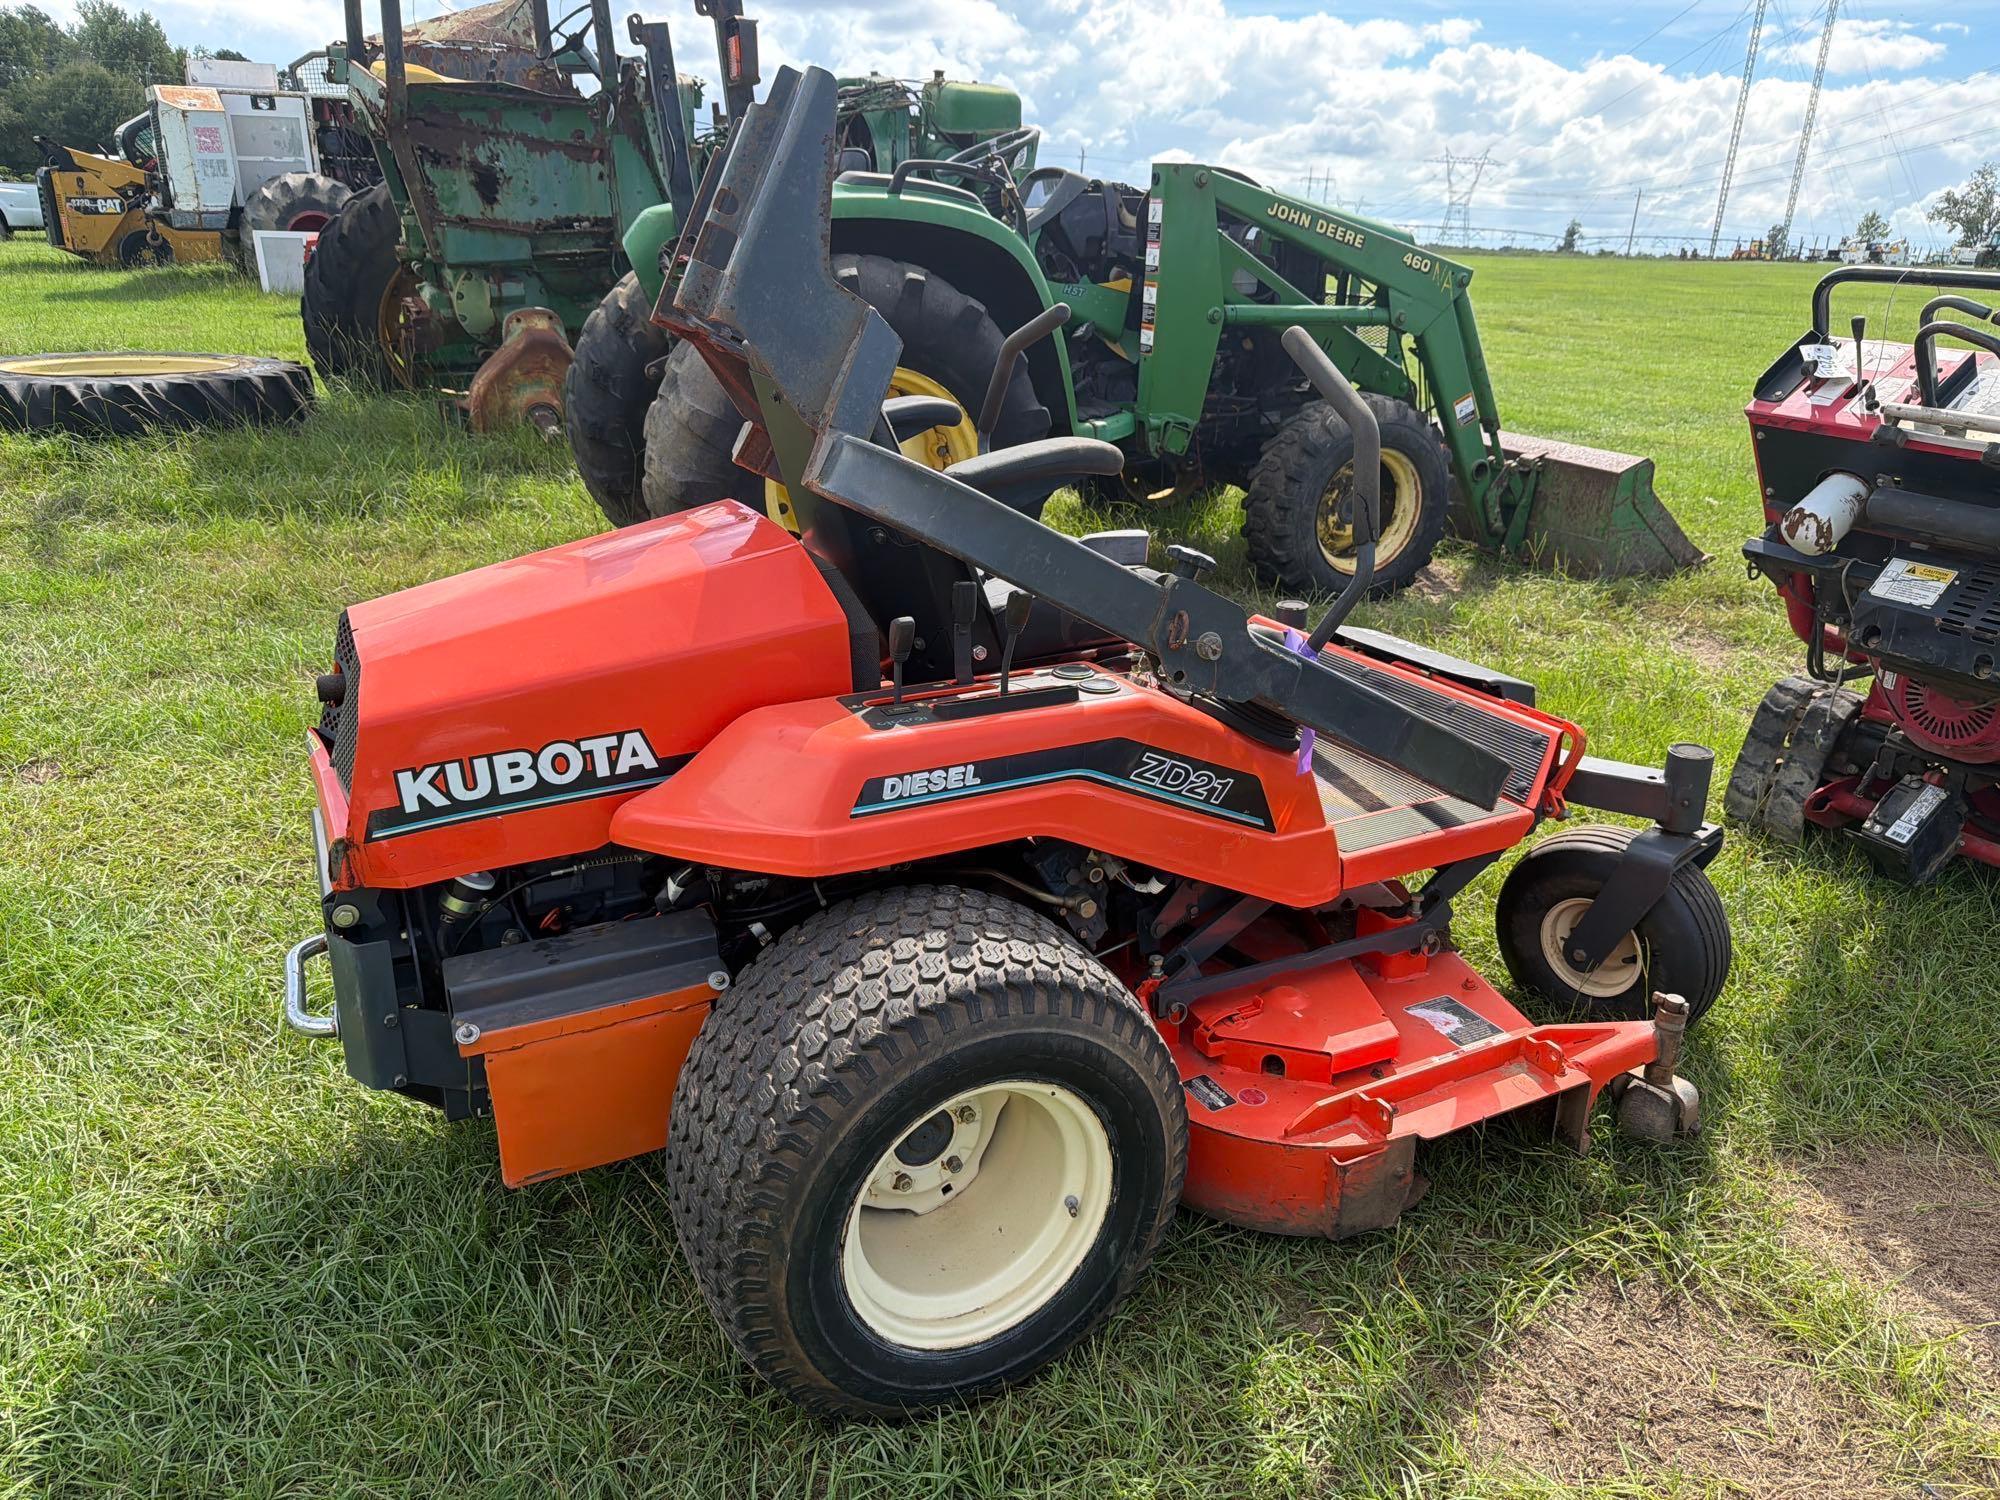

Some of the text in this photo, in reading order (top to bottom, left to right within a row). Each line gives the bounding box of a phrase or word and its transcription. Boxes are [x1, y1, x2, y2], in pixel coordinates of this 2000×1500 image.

[97, 198, 121, 214] CAT
[1267, 202, 1365, 249] JOHN DEERE
[1403, 252, 1431, 274] 460
[397, 731, 659, 814] KUBOTA
[882, 764, 981, 801] DIESEL
[1130, 752, 1234, 805] ZD21
